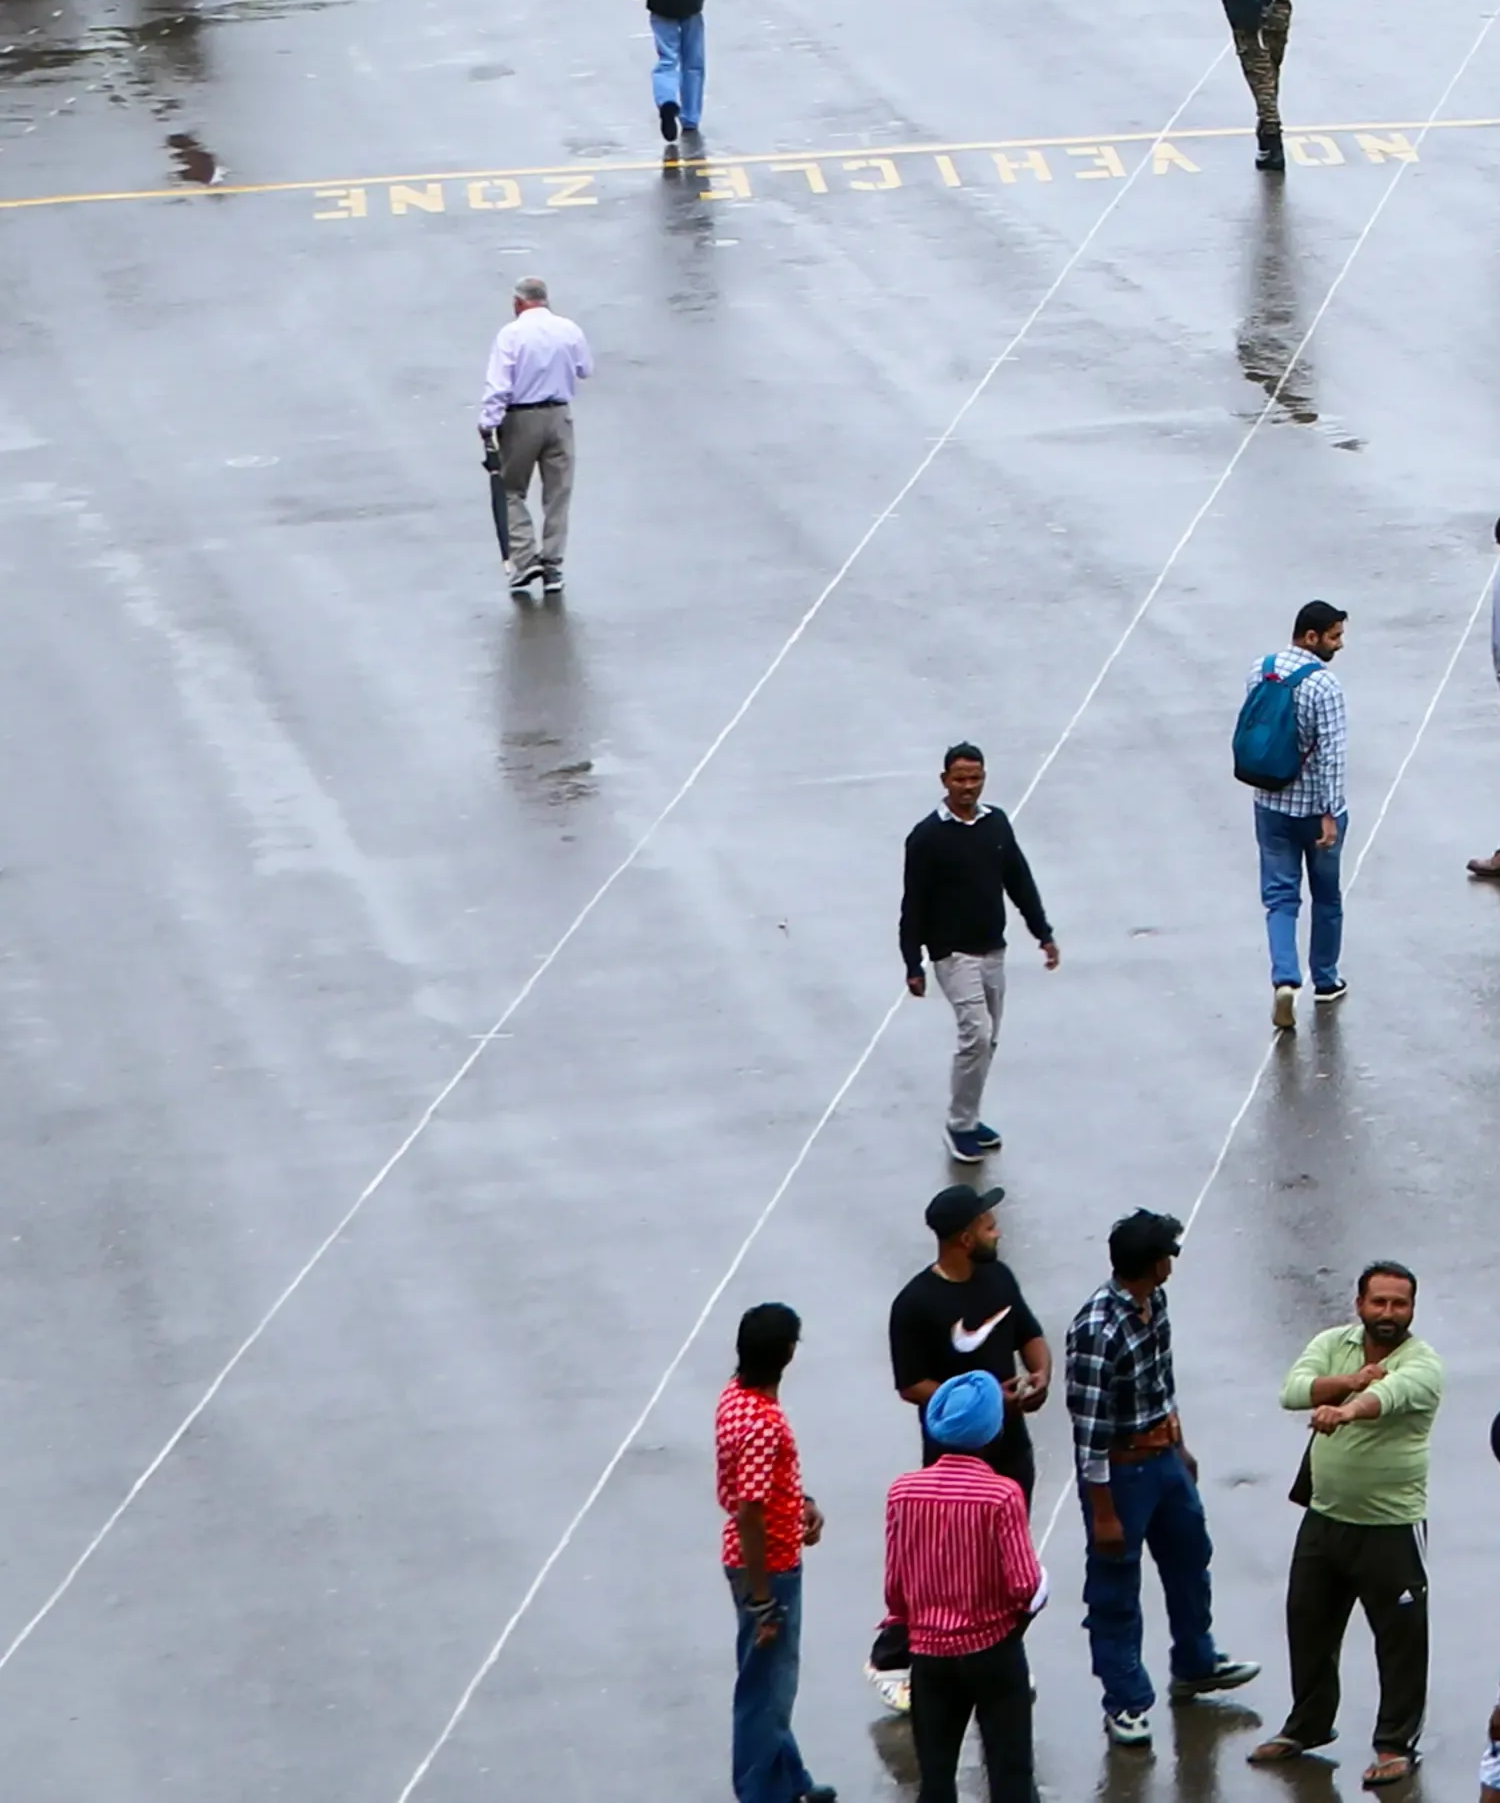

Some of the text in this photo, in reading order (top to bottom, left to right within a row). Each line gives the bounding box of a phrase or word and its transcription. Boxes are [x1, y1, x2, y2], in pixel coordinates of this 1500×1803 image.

[313, 132, 1420, 220] NO VEHICLE ZONE
